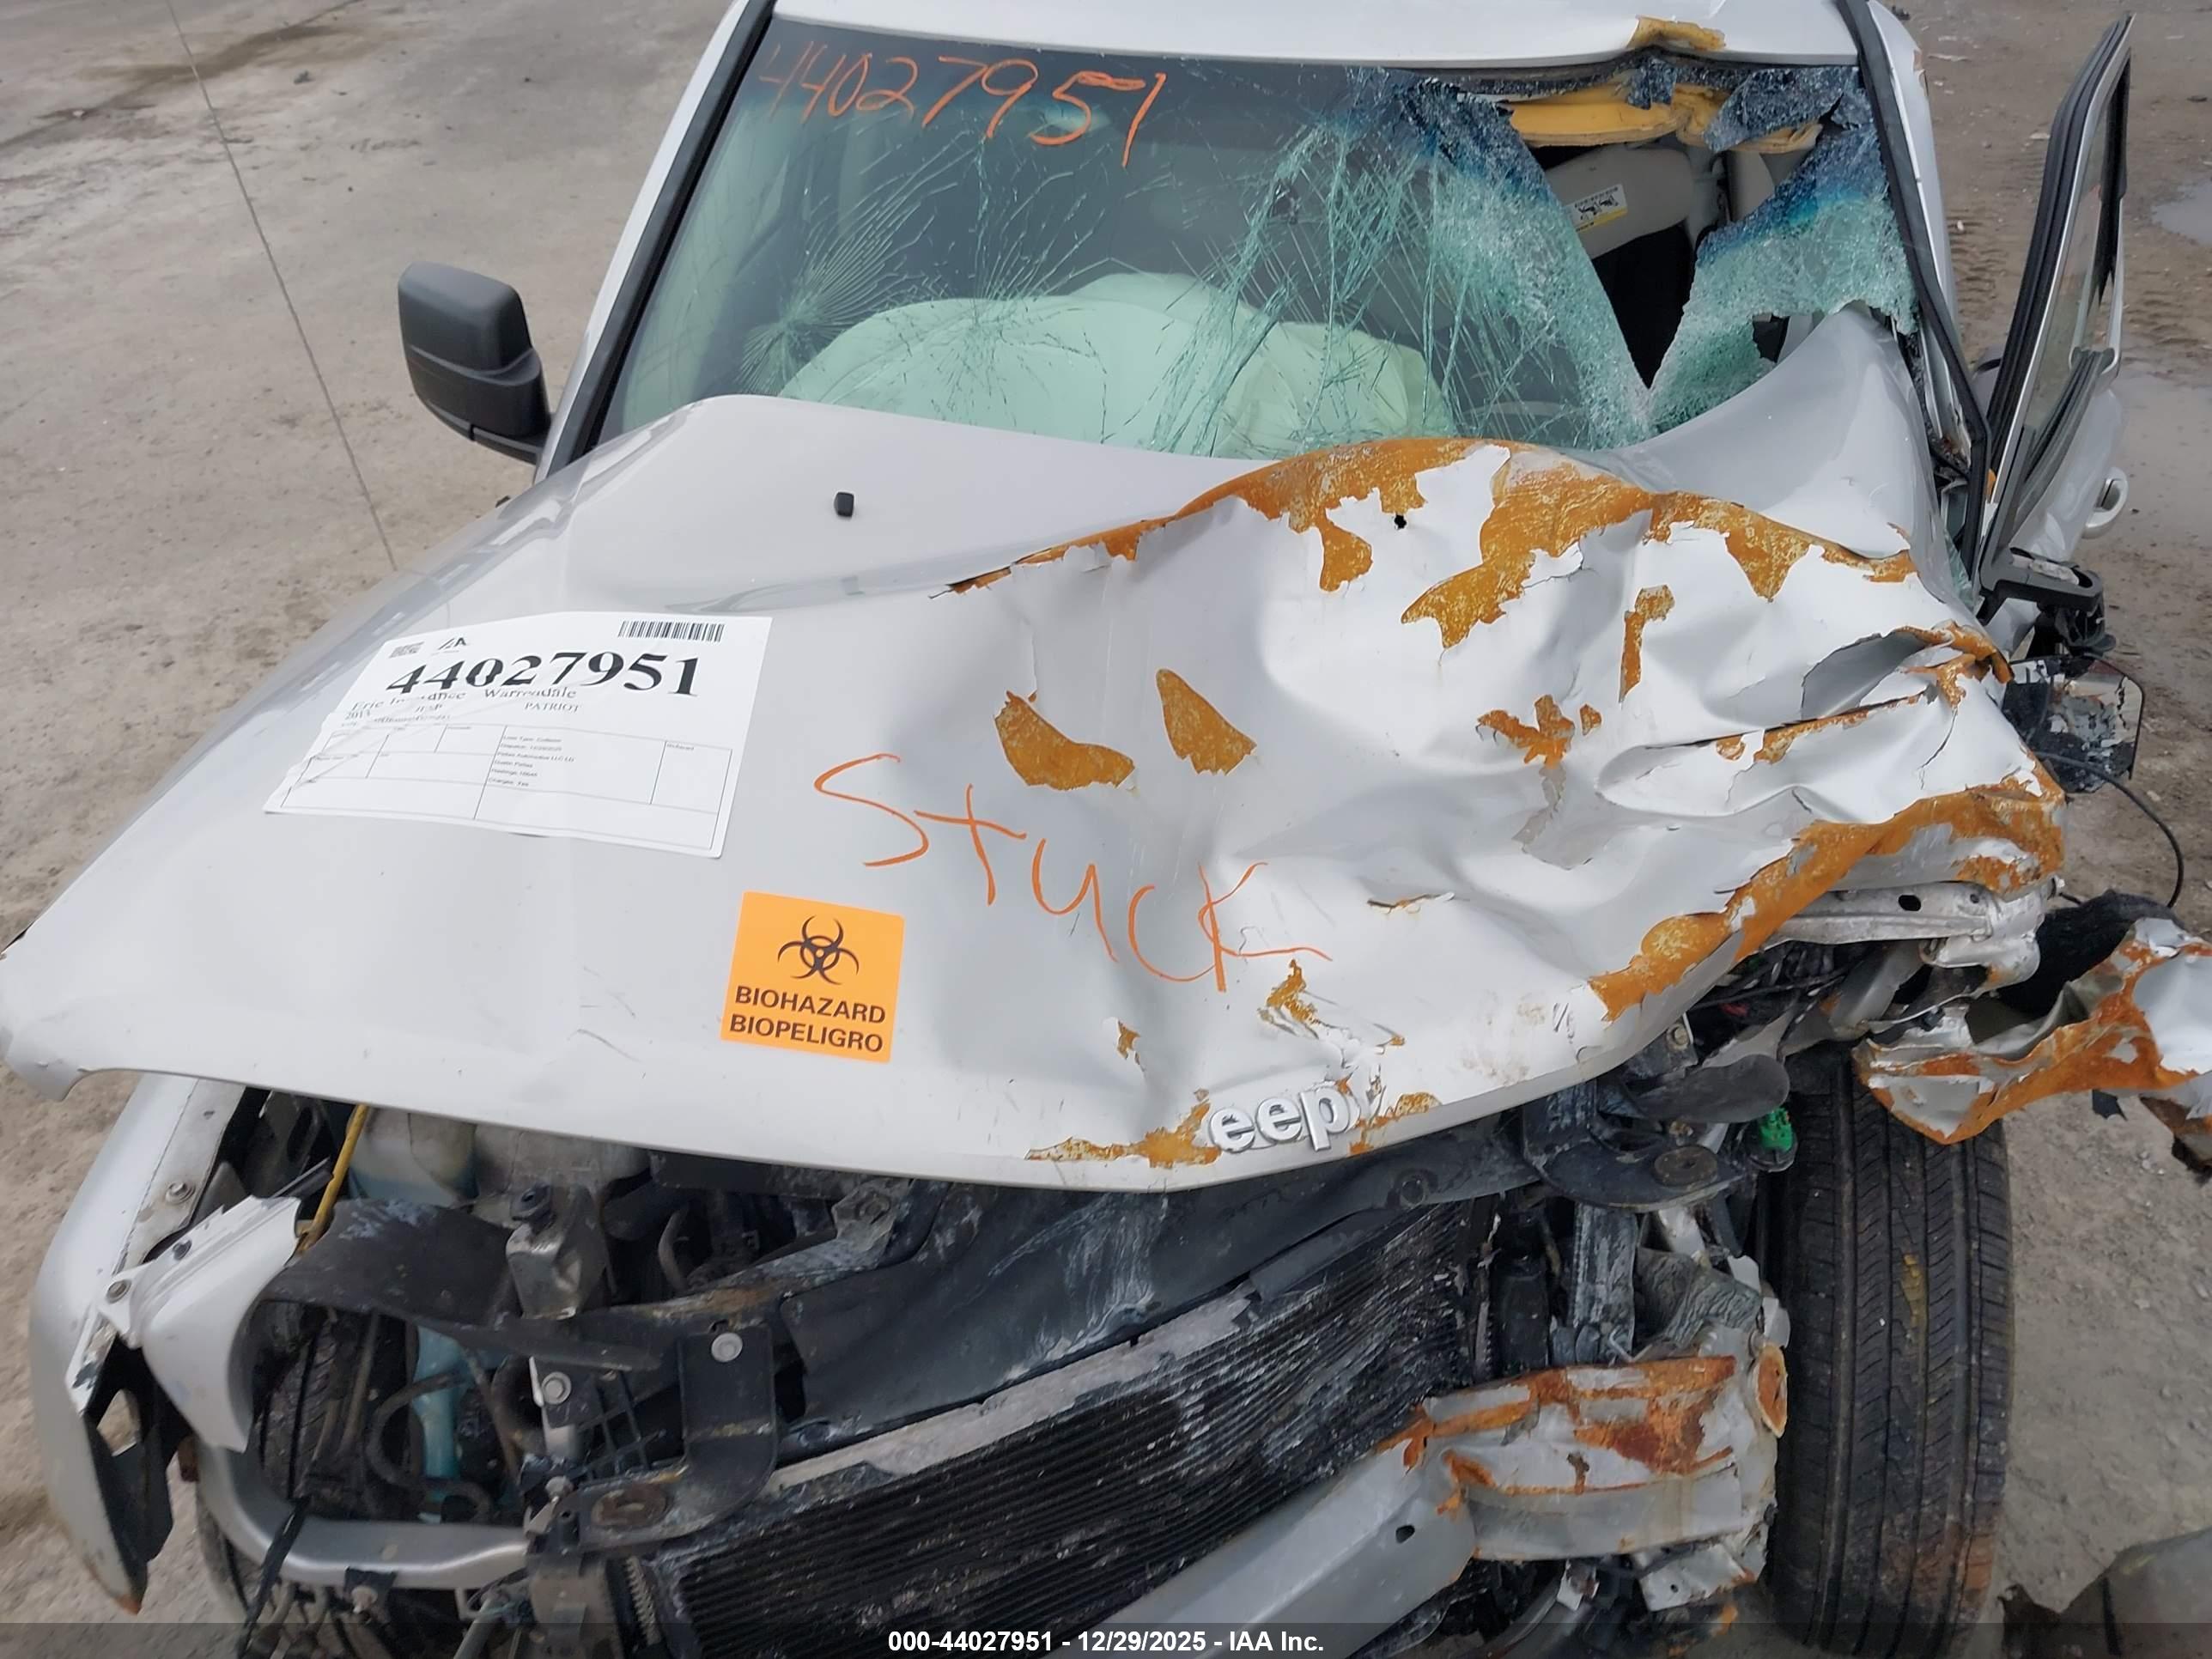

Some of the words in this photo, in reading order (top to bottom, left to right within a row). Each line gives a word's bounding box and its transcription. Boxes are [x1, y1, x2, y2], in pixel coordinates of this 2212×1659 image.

[759, 40, 1167, 168] 44027951
[386, 651, 700, 697] 44027951
[735, 985, 886, 1024] BIOHAZARD
[729, 1013, 884, 1053] BIOPELIGRO
